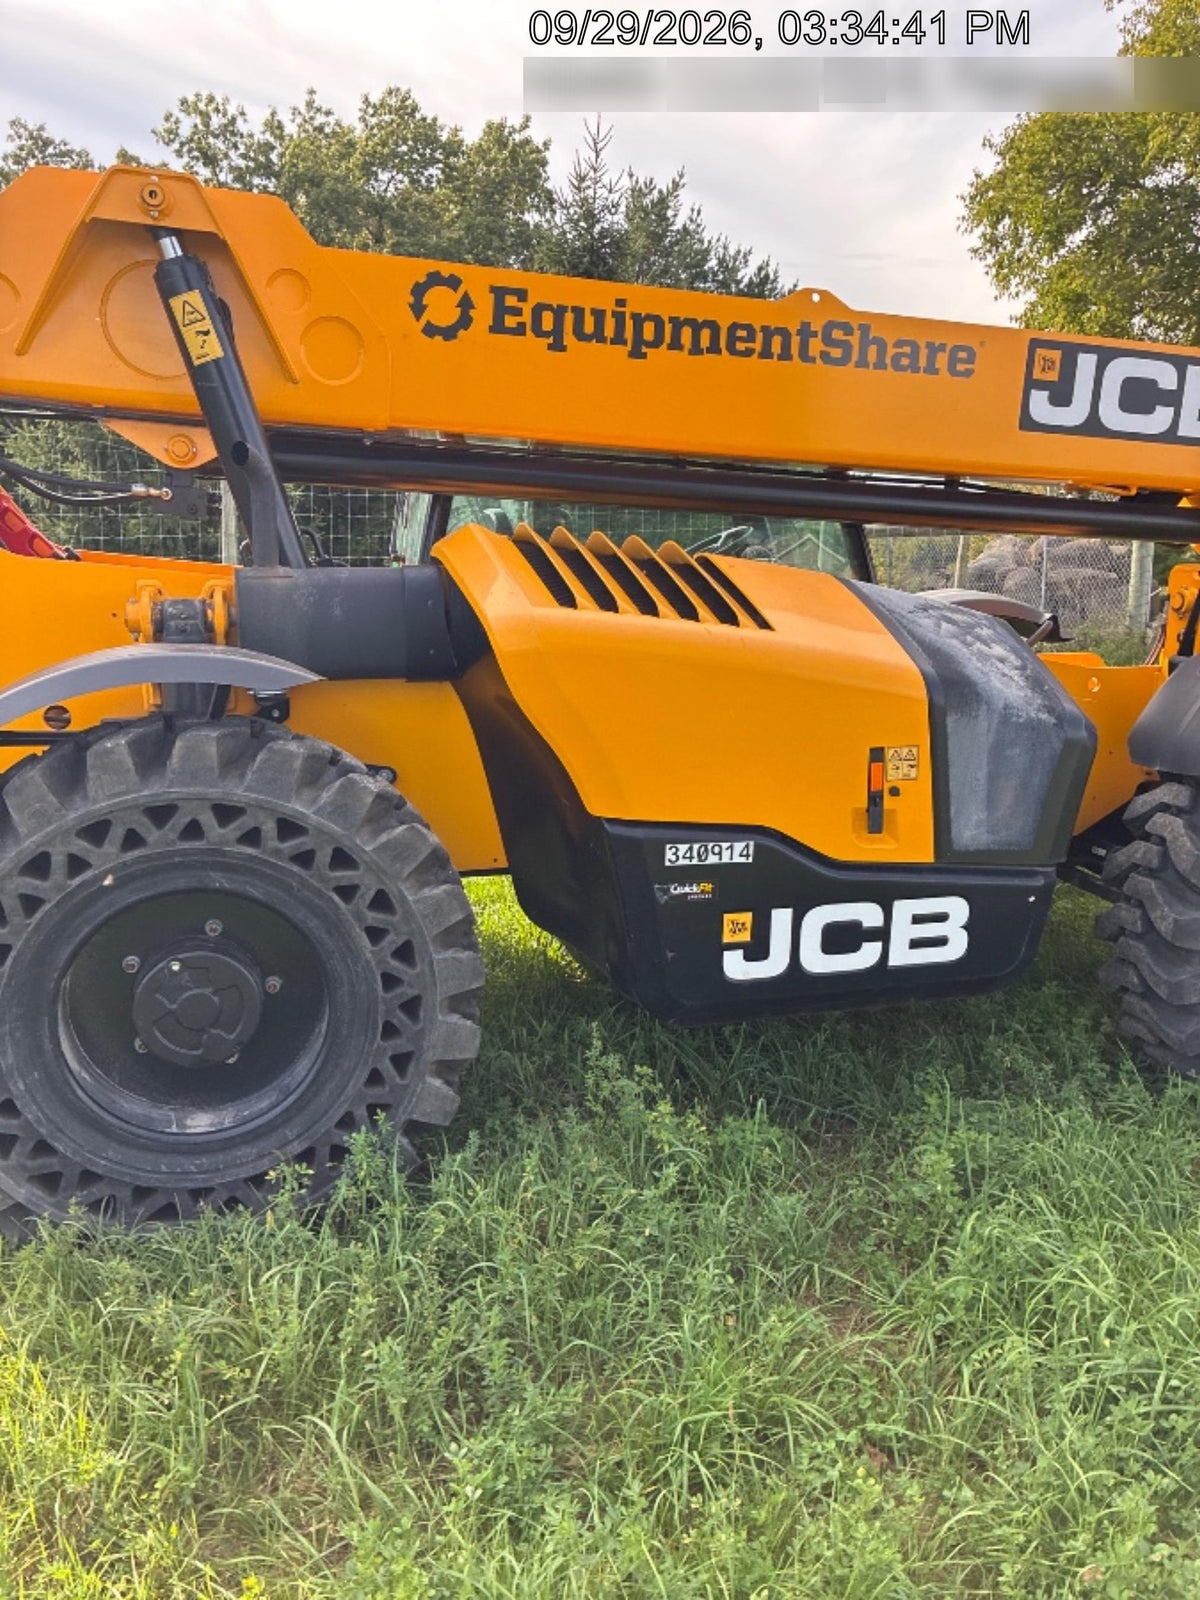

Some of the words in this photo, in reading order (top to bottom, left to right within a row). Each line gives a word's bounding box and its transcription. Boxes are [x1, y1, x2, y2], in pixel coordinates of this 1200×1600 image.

[488, 284, 977, 378] EquipmentShare
[1029, 353, 1200, 438] JC
[667, 842, 751, 865] 340914
[723, 896, 970, 982] JCB
